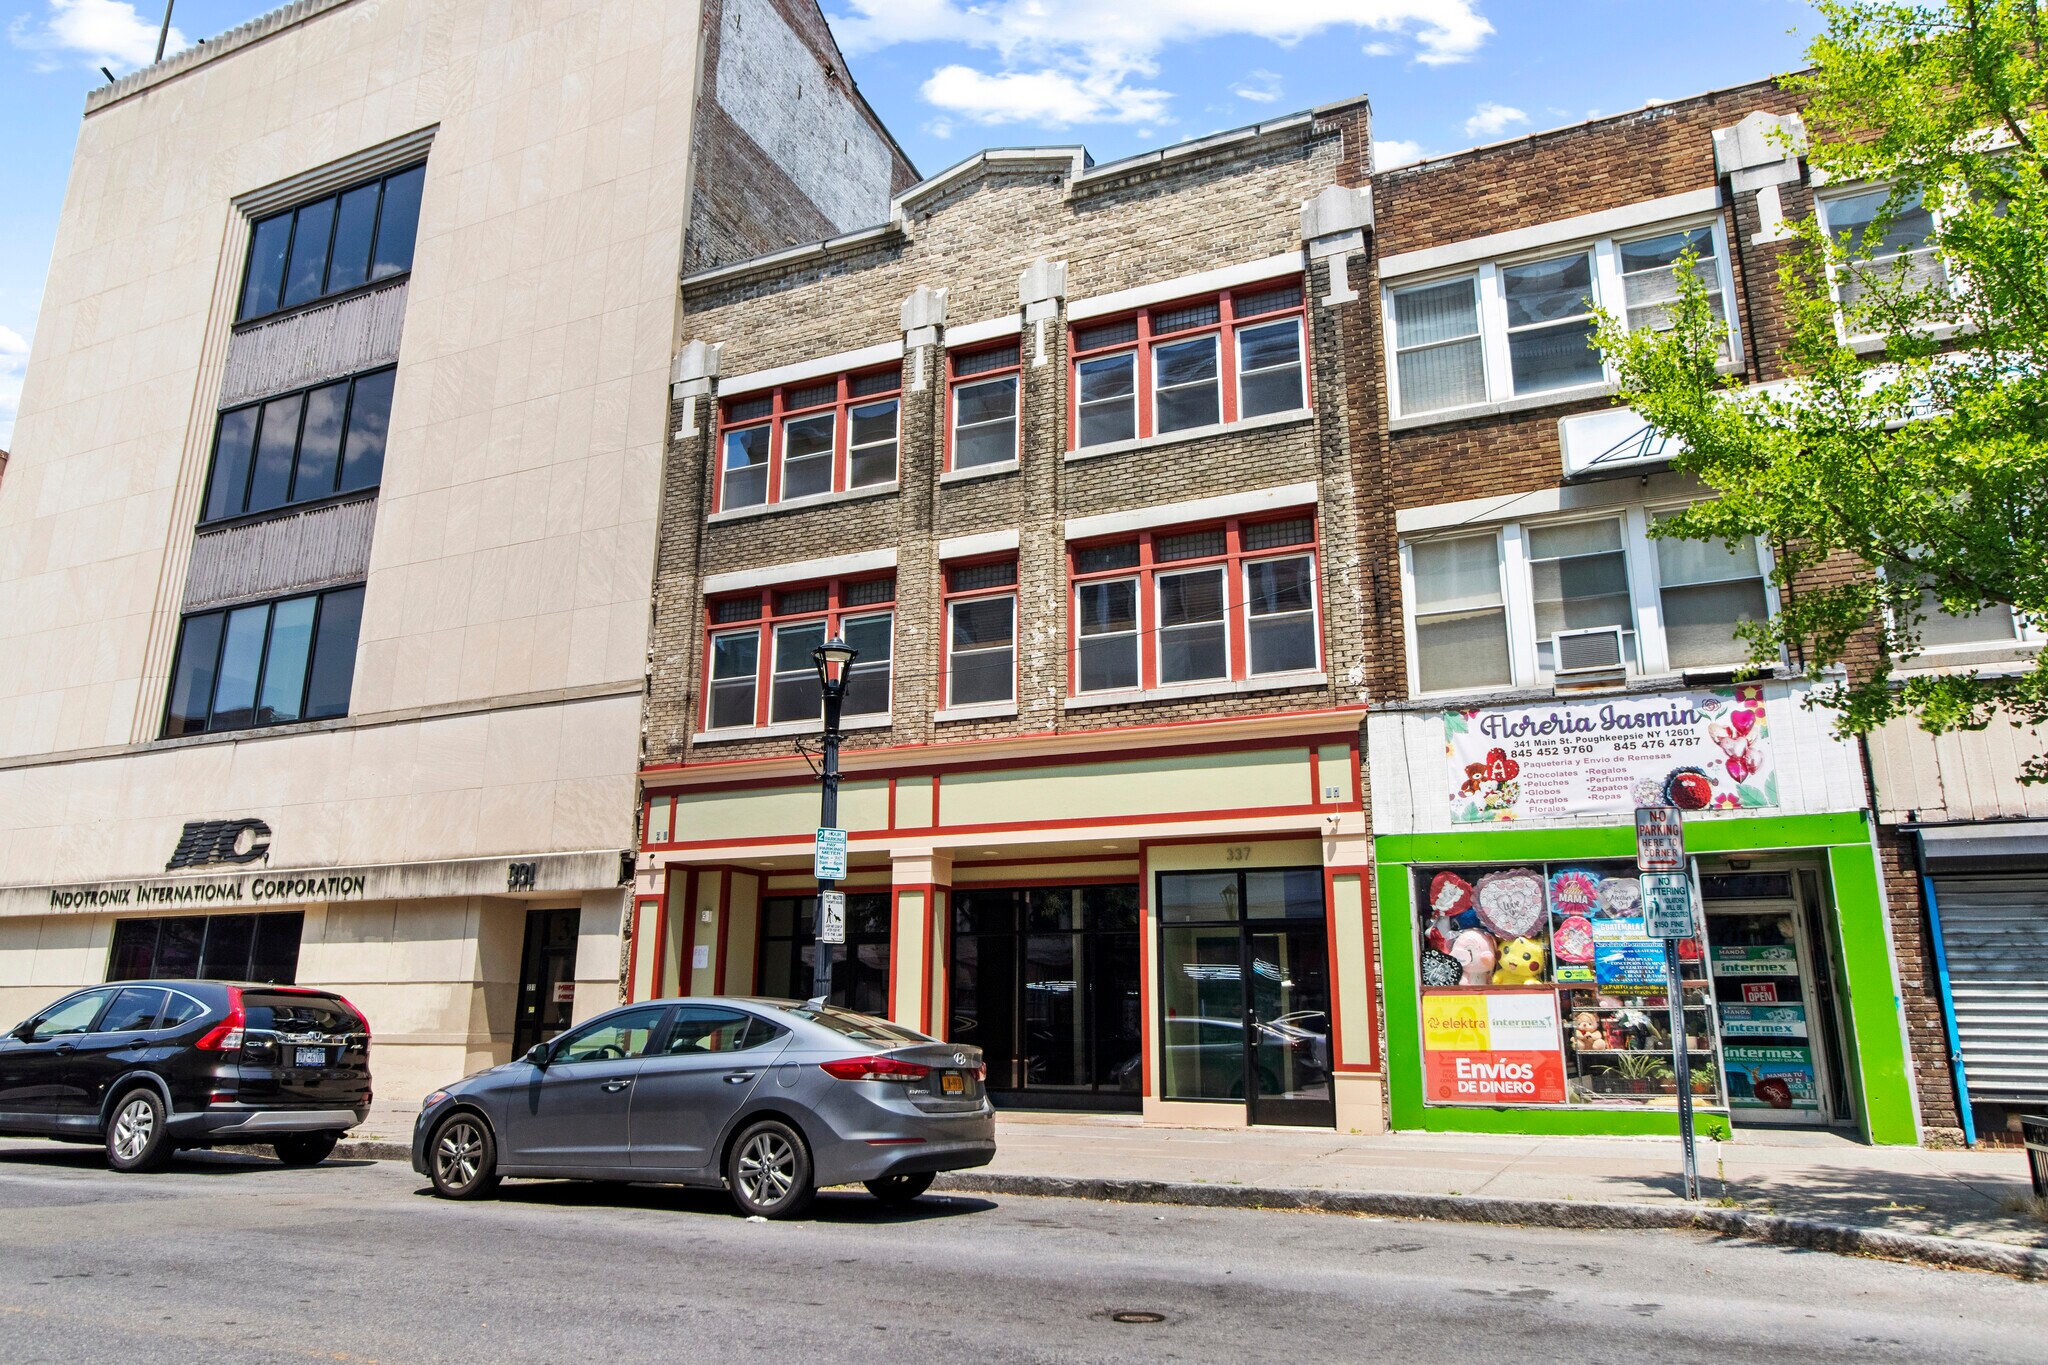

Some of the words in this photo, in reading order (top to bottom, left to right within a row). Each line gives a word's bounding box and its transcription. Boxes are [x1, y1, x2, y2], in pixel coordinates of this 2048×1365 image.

[1480, 711, 1597, 739] Floreria
[1599, 703, 1702, 730] Jasmin
[1514, 740, 1530, 748] 341
[1534, 739, 1556, 747] Main
[1560, 737, 1573, 745] St.
[1575, 732, 1644, 744] Poughkeepsie
[1647, 731, 1661, 739] NY
[1665, 728, 1695, 737] 12601
[1613, 742, 1637, 751] 845
[1641, 740, 1665, 749] 476
[1669, 737, 1701, 747] 4787
[1510, 749, 1533, 758] 845
[1536, 747, 1559, 756] 452
[1563, 745, 1593, 754] 9760
[1627, 753, 1672, 762] Remesas
[1491, 759, 1506, 779] A
[1588, 767, 1627, 775] Regalos
[1526, 770, 1578, 779] Chocolates
[1589, 775, 1635, 783] Perfumes
[1528, 788, 1561, 796] Globos
[1590, 784, 1629, 792] Zapatos
[1529, 797, 1569, 805] Arreglos
[1591, 793, 1621, 801] Ropas
[1529, 805, 1566, 813] Florales
[1649, 810, 1666, 822] NO
[818, 830, 824, 840] 2
[1640, 824, 1679, 836] PARKING
[1642, 838, 1664, 846] HERE
[1668, 838, 1677, 846] TO
[1226, 846, 1251, 861] 337
[1644, 848, 1678, 857] CORNER
[507, 862, 537, 886] 331
[1658, 877, 1670, 886] NO
[50, 888, 131, 907] INDOTRONIX
[136, 882, 243, 902] INTERNATIONAL
[252, 875, 365, 898] CORPORATION
[1645, 887, 1686, 896] LITTERING
[1558, 893, 1588, 904] MAMA
[1600, 923, 1640, 931] GUATEMALA
[1654, 921, 1669, 929] $150
[1721, 963, 1787, 972] intermex
[1748, 992, 1772, 1002] OPEN
[1442, 1017, 1486, 1029] elektra
[1492, 1018, 1546, 1026] intermex
[1726, 1023, 1792, 1033] intermex
[1724, 1046, 1804, 1059] intermex
[1455, 1057, 1534, 1080] Envíos
[1457, 1081, 1480, 1093] DE
[1480, 1081, 1535, 1094] DINERO
